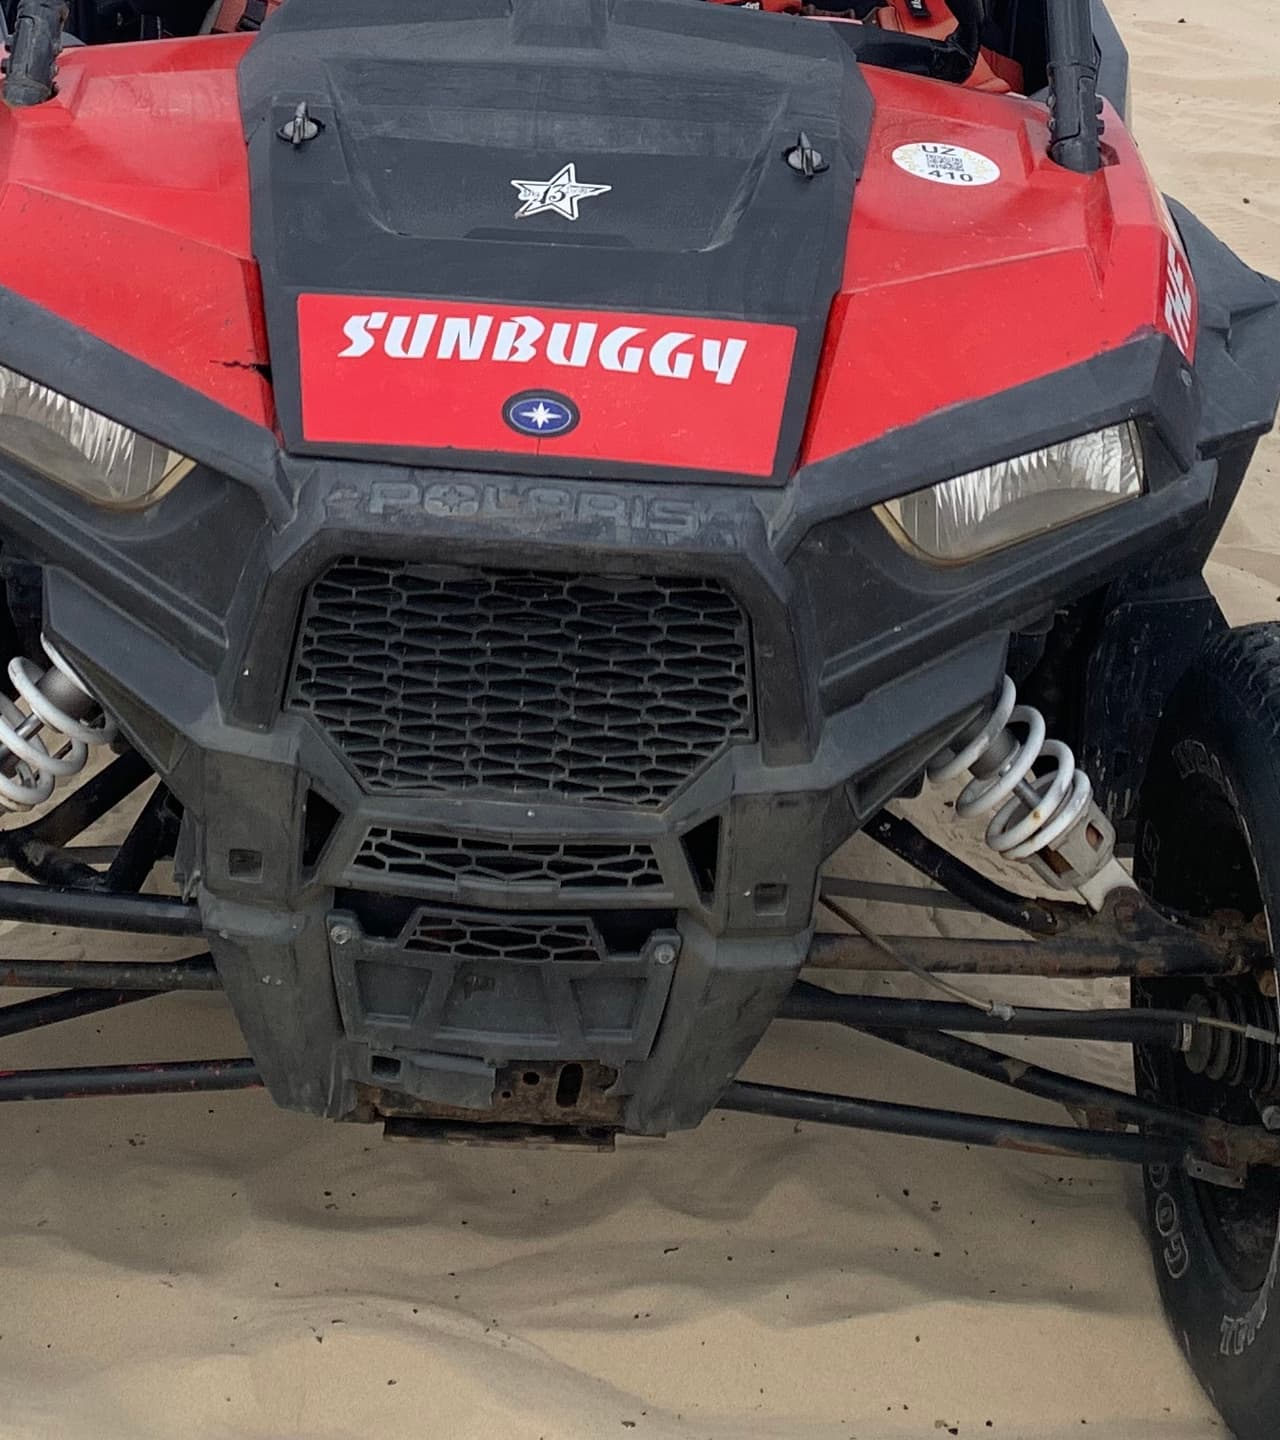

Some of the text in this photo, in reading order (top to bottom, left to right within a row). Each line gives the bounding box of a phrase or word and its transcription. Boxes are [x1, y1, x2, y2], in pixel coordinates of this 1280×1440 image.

[921, 144, 957, 157] UZ
[928, 169, 973, 183] 410
[337, 311, 747, 385] SUNBUGGY
[368, 479, 701, 532] POLARIS
